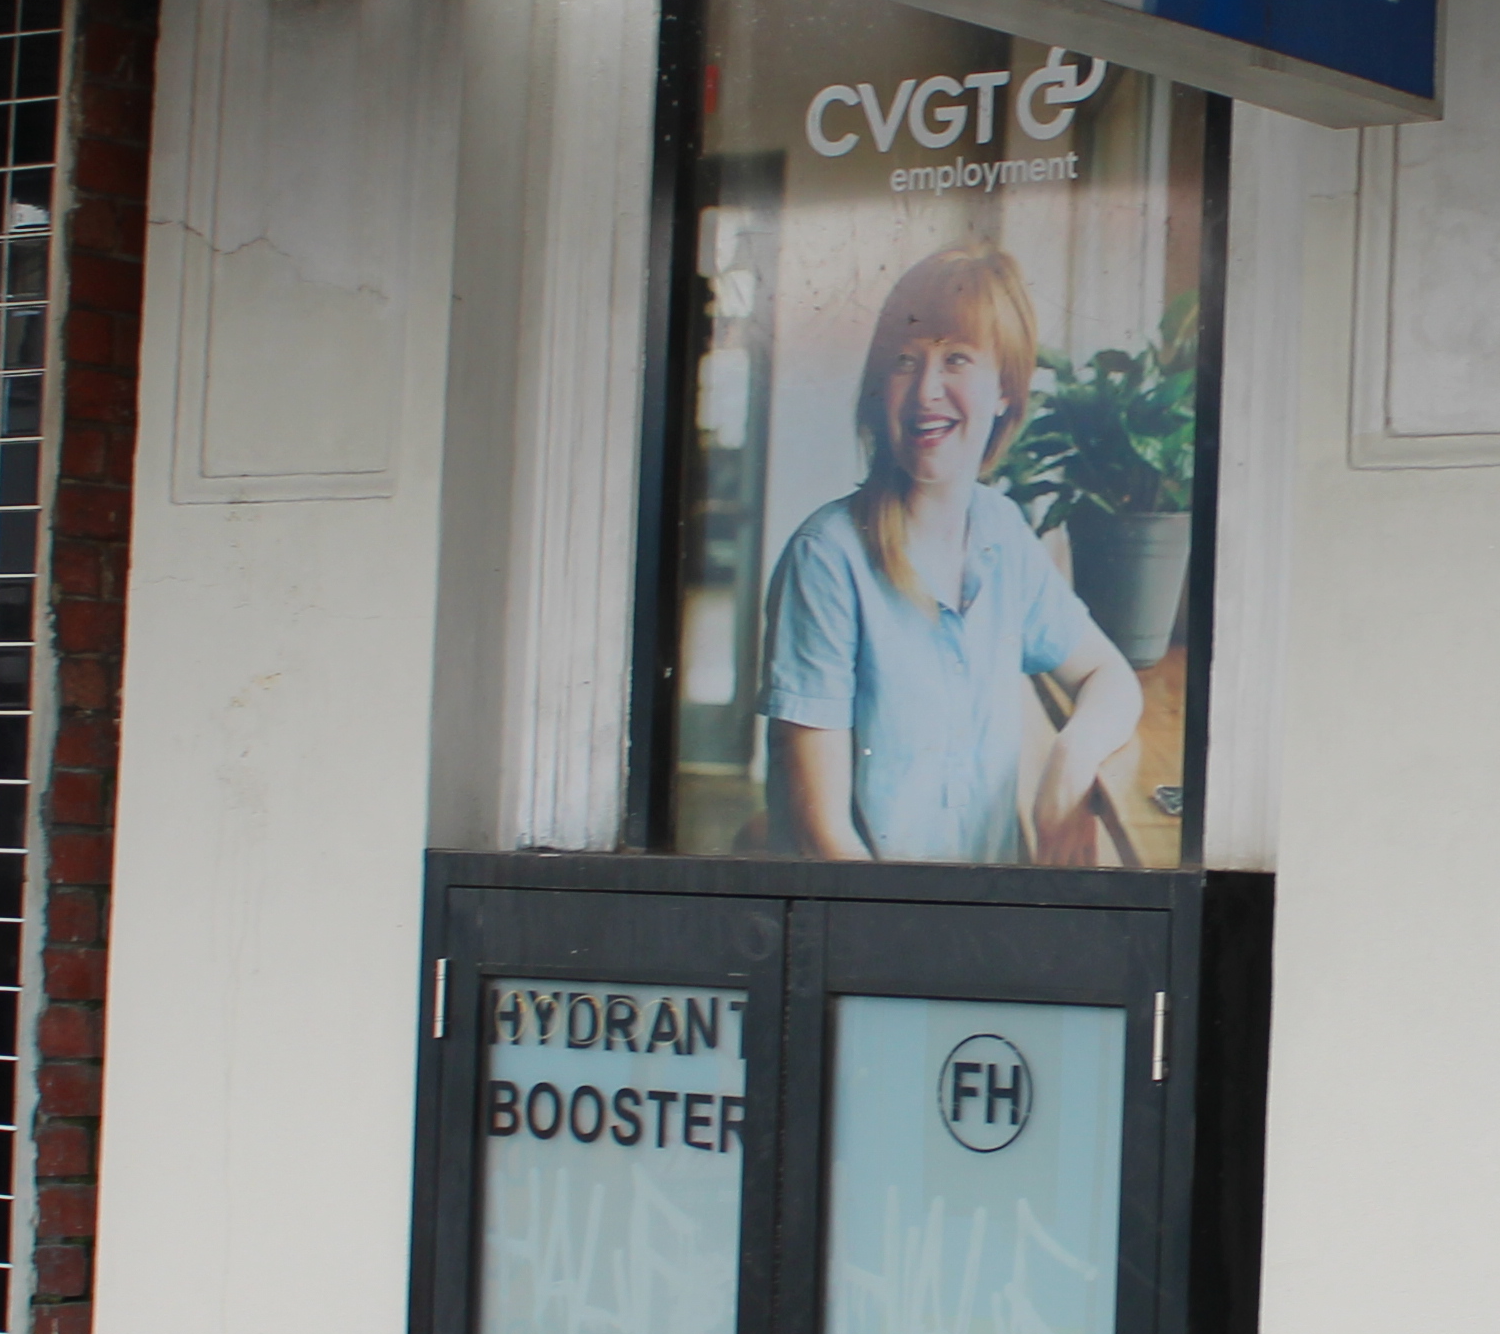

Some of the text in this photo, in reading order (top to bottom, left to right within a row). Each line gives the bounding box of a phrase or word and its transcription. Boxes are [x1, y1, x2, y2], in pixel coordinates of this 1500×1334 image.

[806, 69, 1010, 158] CVGT
[889, 149, 1080, 198] employment
[489, 985, 746, 1059] HYDRANT
[488, 1078, 746, 1154] BOOSTER
[951, 1061, 1023, 1128] FH
